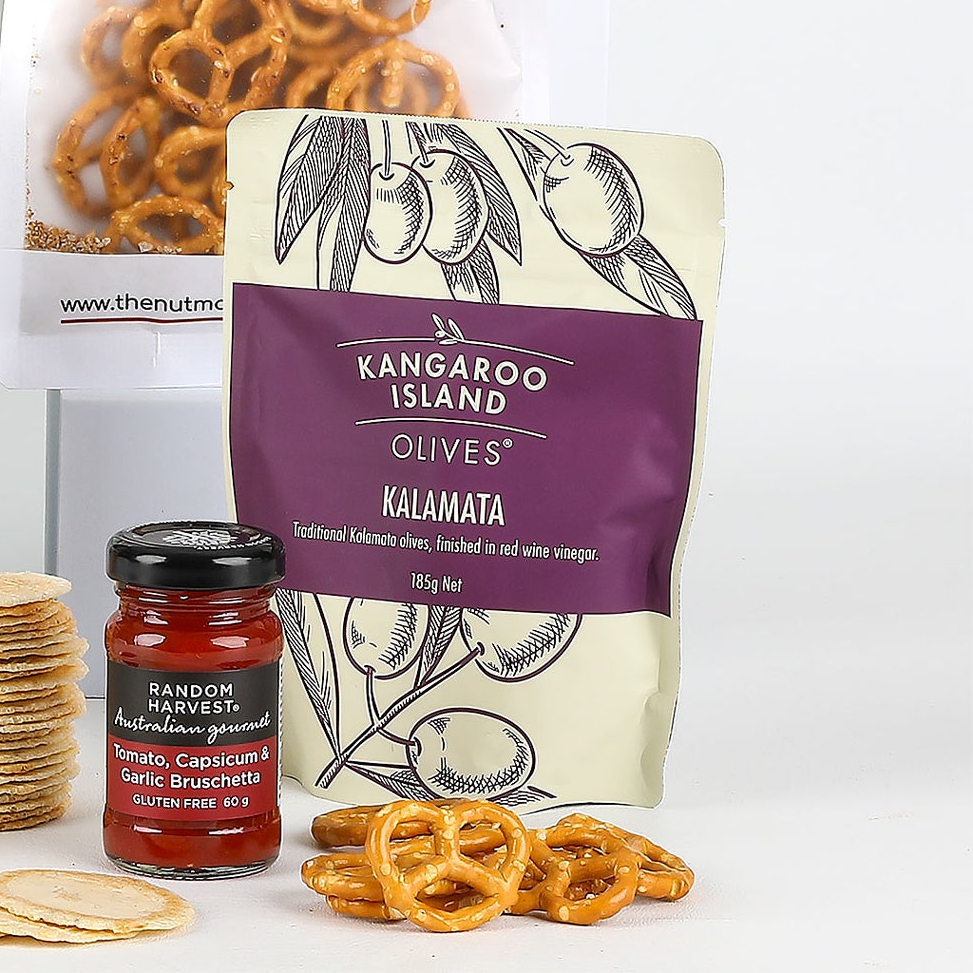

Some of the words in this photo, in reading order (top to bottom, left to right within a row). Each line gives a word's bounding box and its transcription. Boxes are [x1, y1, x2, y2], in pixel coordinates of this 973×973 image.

[60, 293, 224, 313] www.thenutm
[357, 351, 548, 391] KANGAROO
[390, 383, 507, 415] ISLAND
[382, 485, 505, 526] KALAMATA
[292, 521, 347, 543] Traditional
[349, 527, 397, 548] Kalamata
[399, 531, 433, 554] olives,
[436, 535, 482, 555] finished
[485, 539, 496, 555] in
[499, 539, 518, 557] red
[521, 541, 550, 559] wine
[553, 544, 600, 564] vinegar.
[410, 572, 439, 594] 185g
[442, 576, 463, 593] Net
[149, 682, 233, 698] RANDOM
[114, 706, 206, 733] Australian
[207, 711, 271, 744] gourmet
[113, 743, 171, 769] Tomato,
[175, 749, 258, 771] Capsicum
[260, 745, 270, 761] &
[121, 768, 165, 788] Garlic
[170, 771, 261, 789] Bruschetta
[132, 794, 180, 808] GLUTEN
[183, 797, 217, 809] FREE
[223, 796, 239, 807] 60
[241, 796, 249, 808] g
